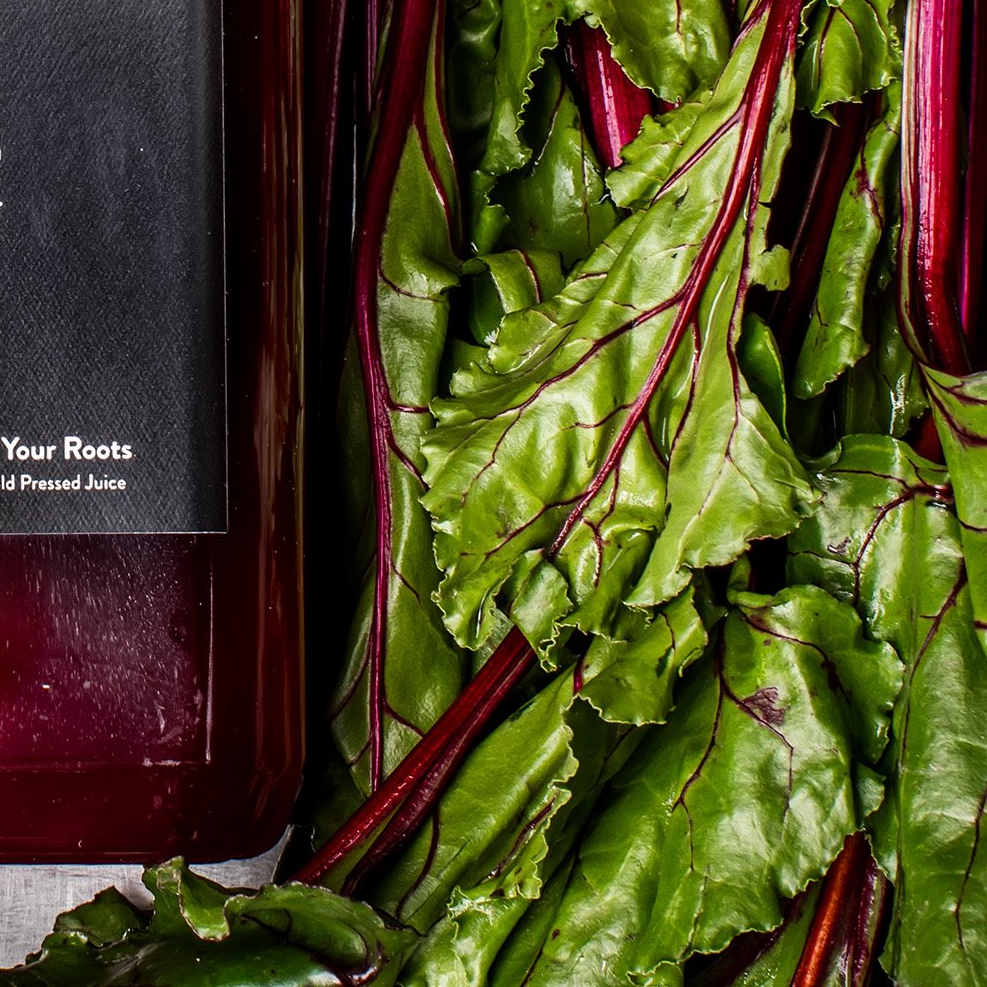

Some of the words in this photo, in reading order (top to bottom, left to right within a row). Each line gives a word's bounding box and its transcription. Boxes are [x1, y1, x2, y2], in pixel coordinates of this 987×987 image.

[1, 436, 57, 461] Your
[63, 436, 133, 461] Roots
[20, 474, 81, 492] Pressed
[84, 474, 127, 492] Juice
